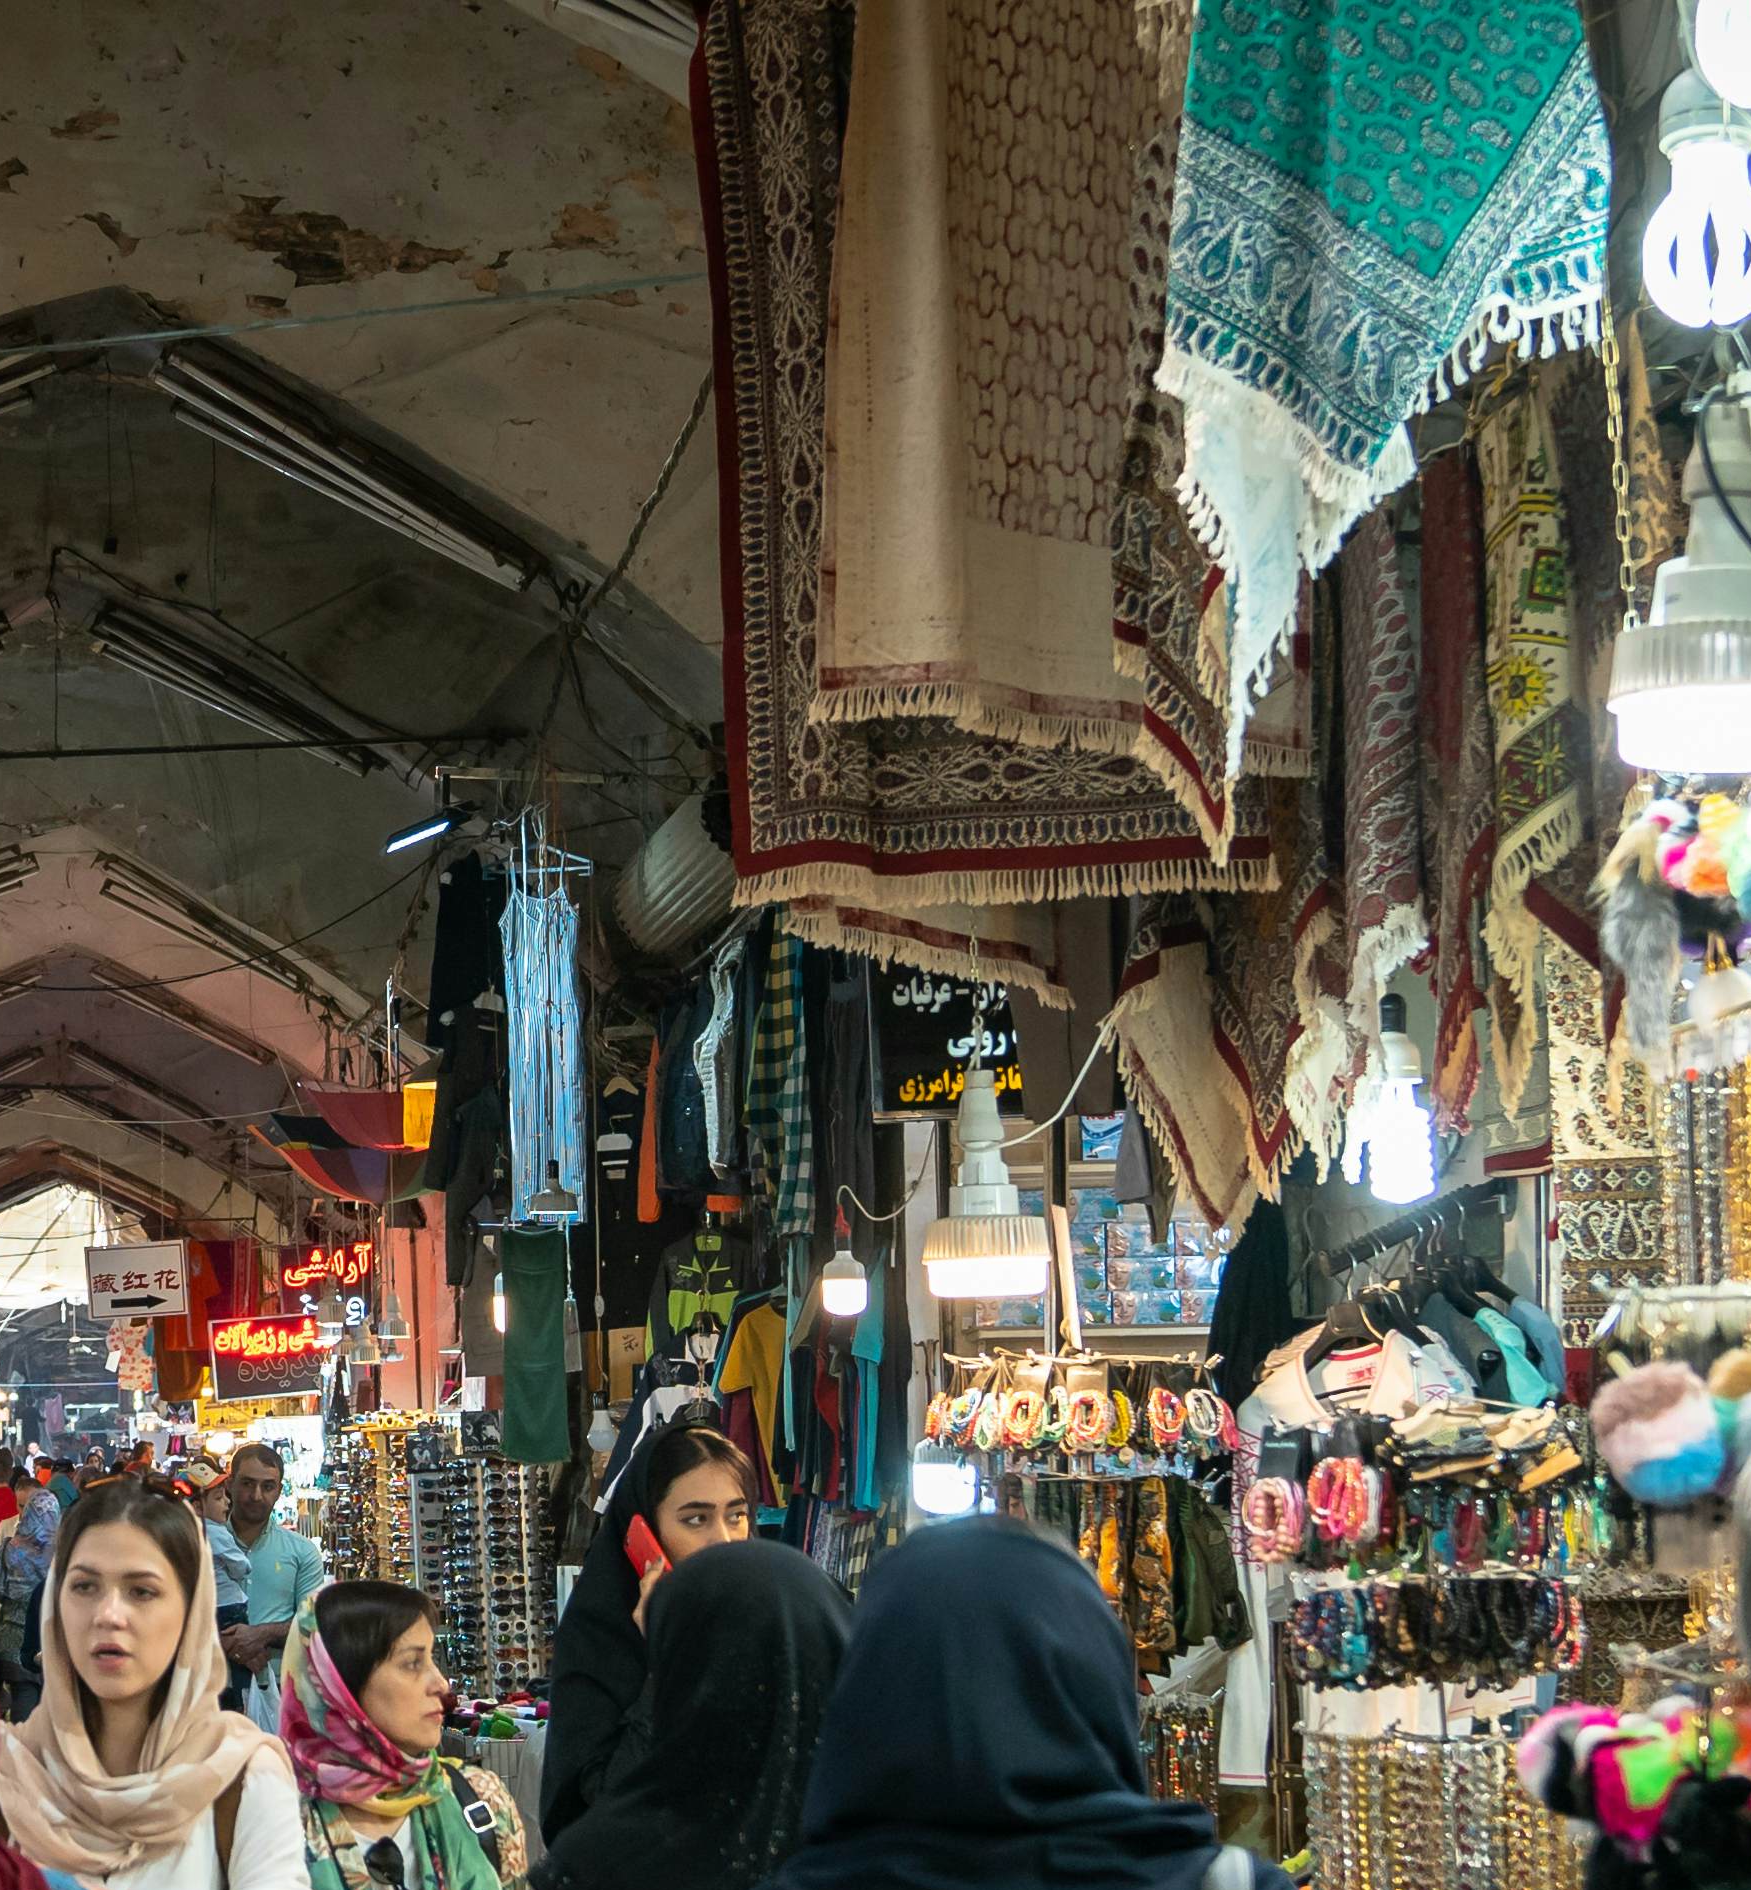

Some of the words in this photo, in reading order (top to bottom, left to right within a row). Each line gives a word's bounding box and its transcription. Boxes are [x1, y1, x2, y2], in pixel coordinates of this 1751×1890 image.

[899, 1063, 965, 1103] فرامرزی
[92, 1269, 181, 1295] 藏红花
[284, 1243, 373, 1288] آرایشی
[214, 1321, 277, 1357] زیورآلات
[464, 1443, 502, 1454] POLICE
